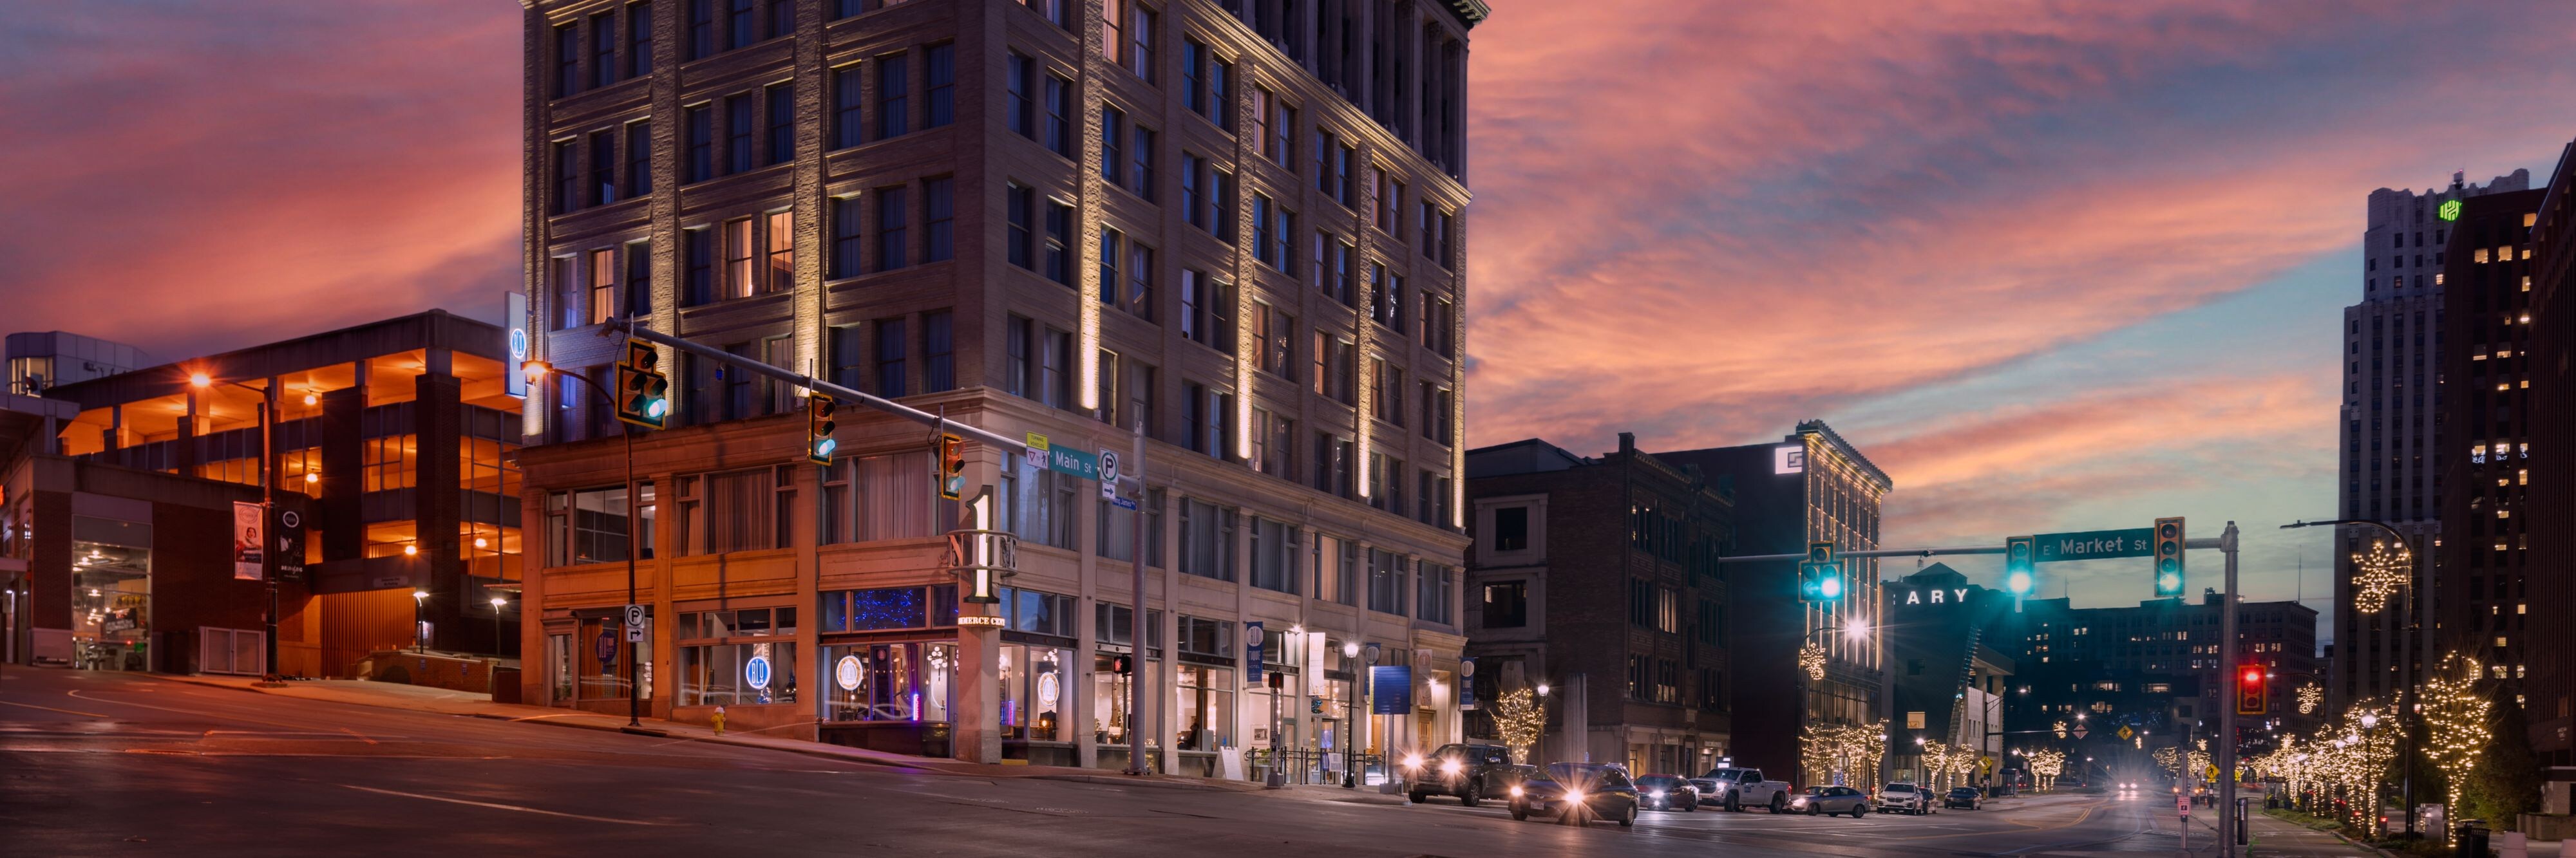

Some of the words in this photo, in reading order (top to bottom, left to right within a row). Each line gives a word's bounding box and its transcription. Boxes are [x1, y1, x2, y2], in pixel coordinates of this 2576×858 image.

[1056, 451, 1079, 471] Main
[1084, 463, 1092, 473] St
[1106, 458, 1113, 474] P
[2043, 545, 2050, 555] E
[2061, 536, 2123, 555] Market
[2134, 539, 2147, 550] St
[1893, 589, 1968, 605] ARY
[632, 610, 640, 622] P
[752, 659, 764, 684] BLU
